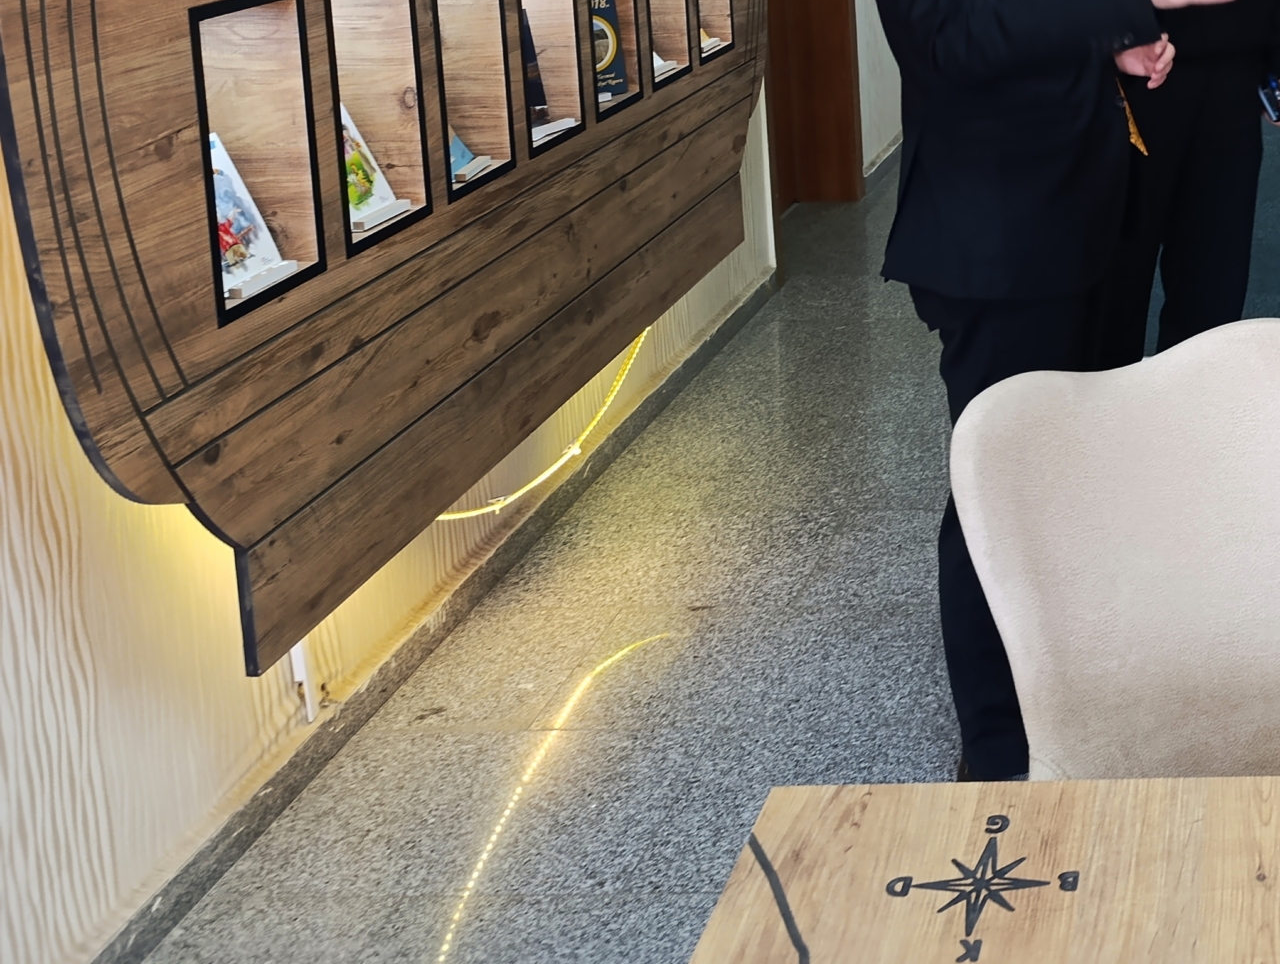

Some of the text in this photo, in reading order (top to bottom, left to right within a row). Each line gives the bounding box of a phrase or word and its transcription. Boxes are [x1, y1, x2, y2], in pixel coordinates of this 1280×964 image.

[985, 814, 1010, 834] G
[886, 876, 913, 897] D
[1057, 870, 1080, 892] B
[955, 939, 983, 963] K
